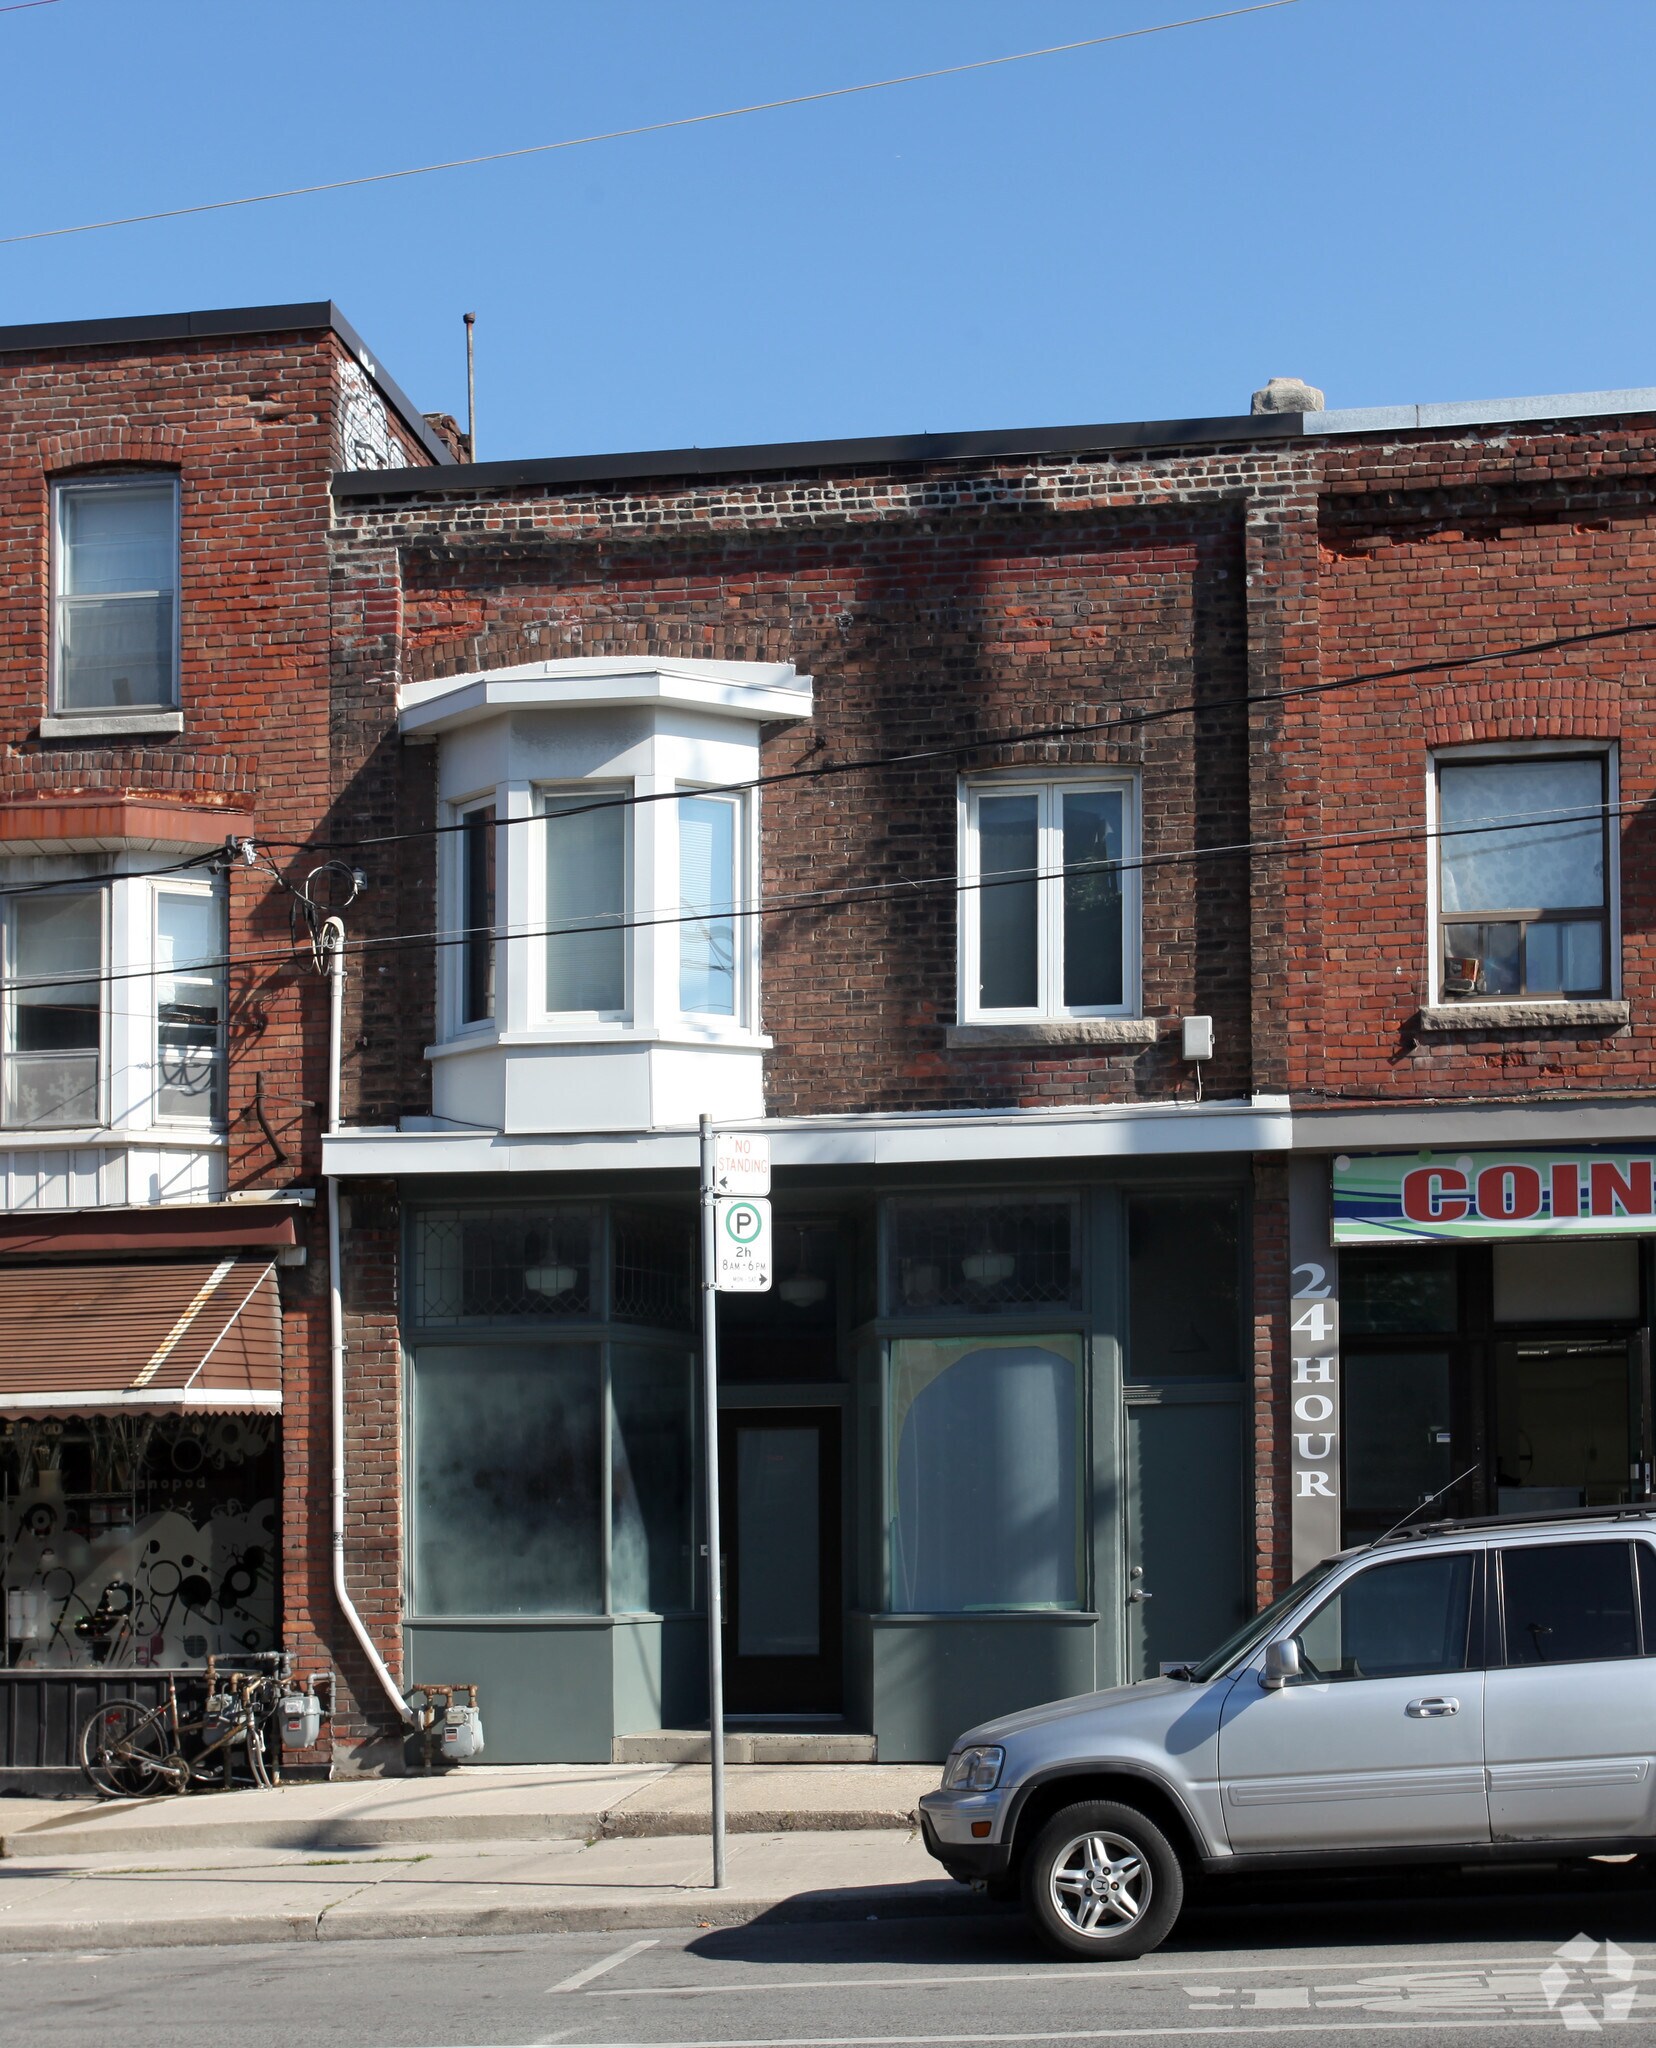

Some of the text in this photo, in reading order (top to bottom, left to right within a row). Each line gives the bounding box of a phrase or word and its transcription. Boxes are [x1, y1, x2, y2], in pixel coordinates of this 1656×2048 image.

[735, 1139, 751, 1154] NO
[718, 1157, 767, 1174] STANDING
[1402, 1159, 1654, 1223] COIN
[736, 1213, 752, 1234] P
[736, 1246, 751, 1257] 2h
[126, 1475, 206, 1493] nanopod
